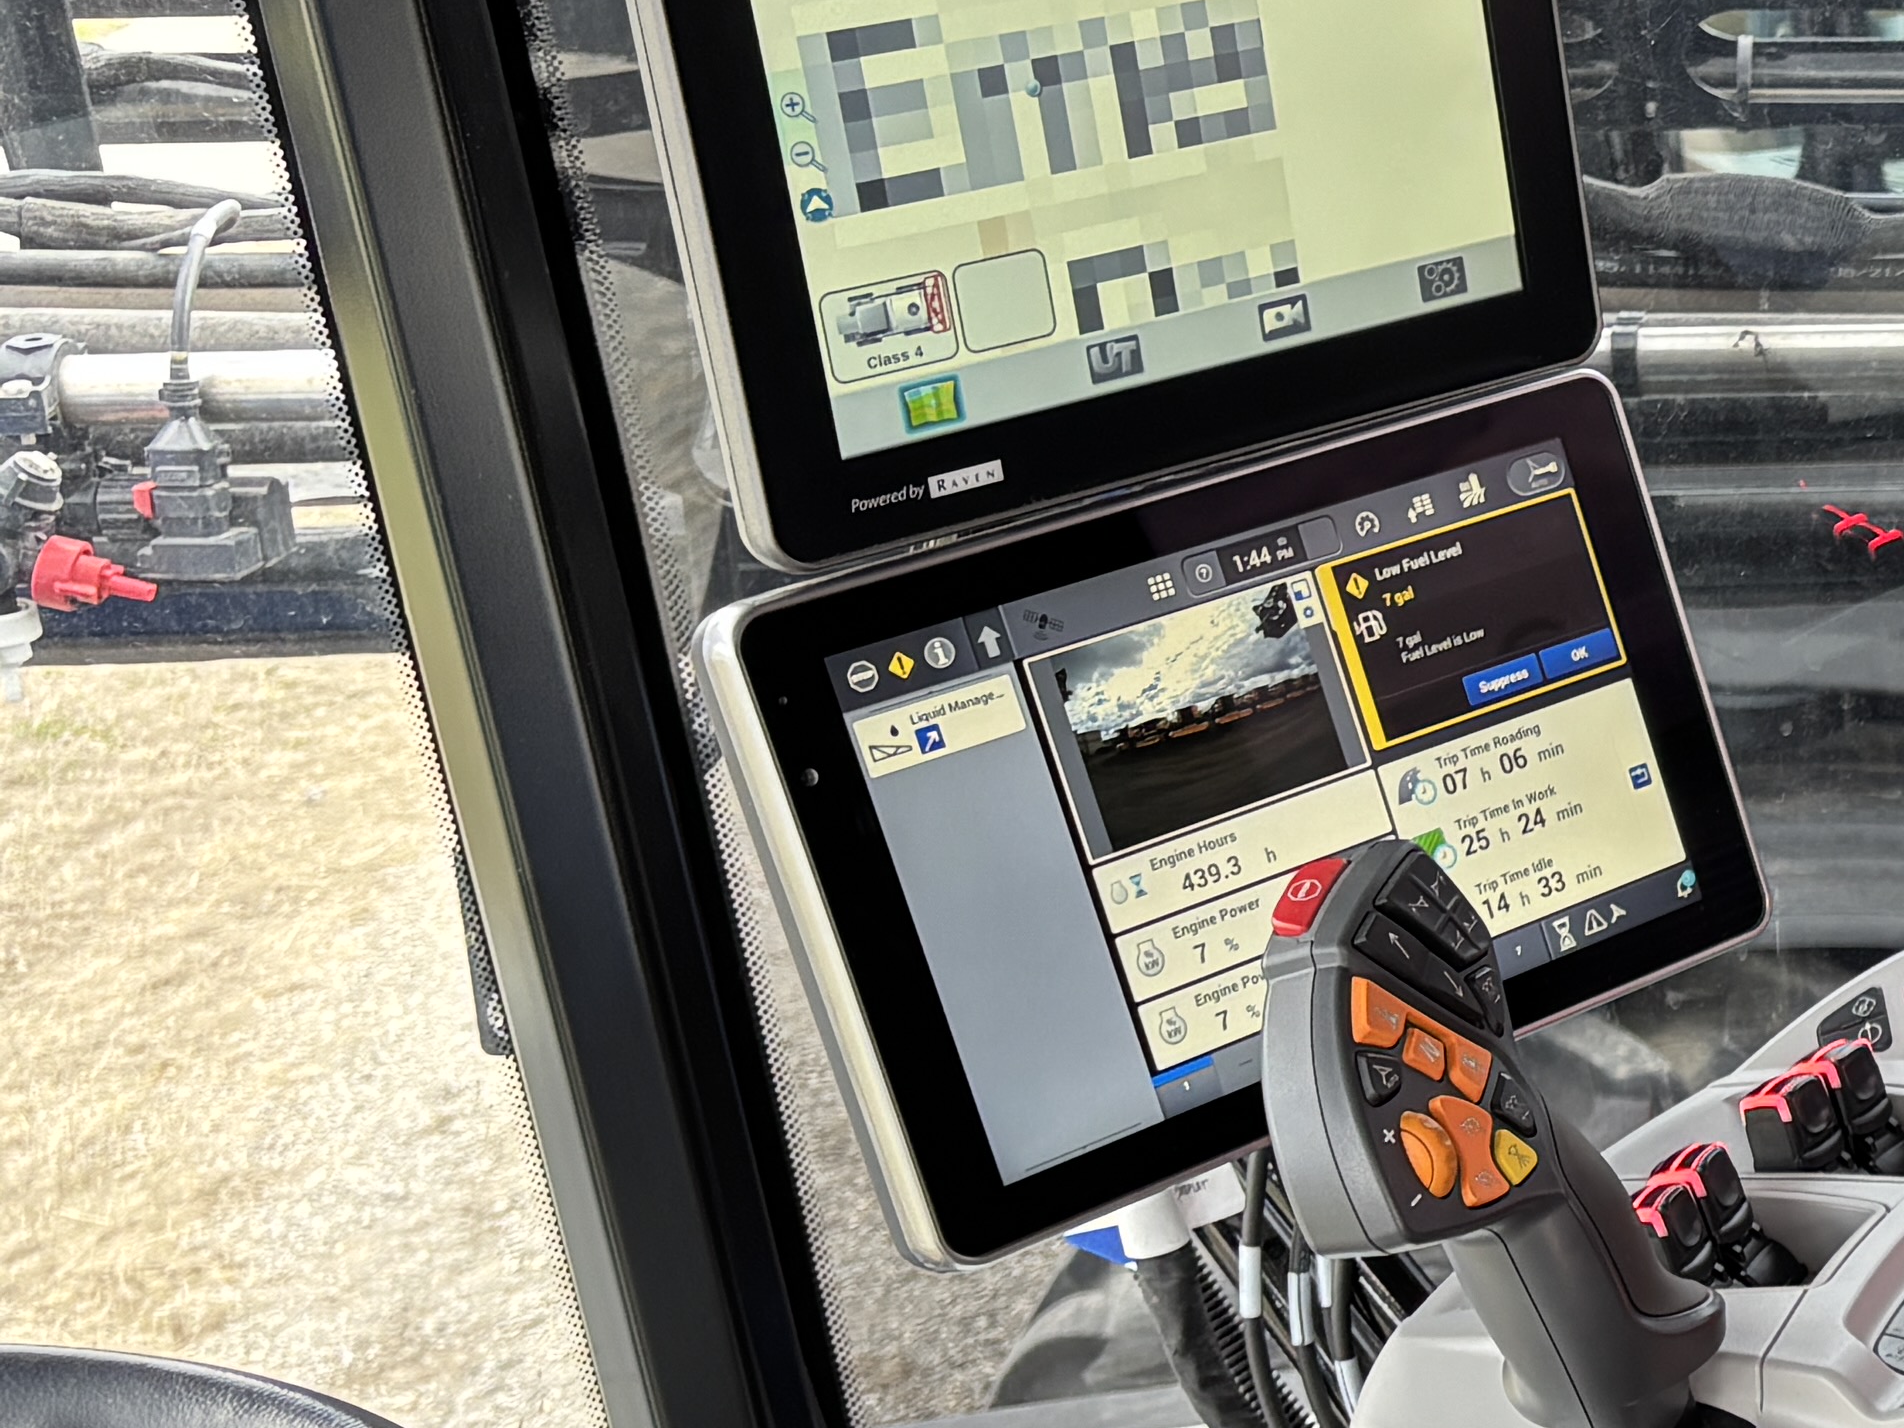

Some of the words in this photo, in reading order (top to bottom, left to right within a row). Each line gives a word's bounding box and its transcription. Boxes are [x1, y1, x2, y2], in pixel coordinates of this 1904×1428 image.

[866, 348, 909, 371] Class
[914, 345, 925, 359] 4
[851, 487, 908, 514] Powered
[908, 482, 925, 501] by
[1232, 546, 1273, 573] 1:44
[1276, 545, 1294, 561] PM
[1375, 561, 1401, 582] Low
[1402, 553, 1430, 574] Fuel
[1430, 541, 1463, 566] Level
[1382, 592, 1392, 607] 7
[1394, 585, 1415, 606] gal
[1396, 636, 1405, 649] 7
[1406, 630, 1422, 649] gal
[1401, 645, 1425, 664] Fuel
[1425, 636, 1452, 657] Level
[1452, 634, 1460, 648] is
[1462, 627, 1485, 645] Low
[1570, 645, 1589, 661] OK
[1478, 667, 1529, 695] Suppress
[909, 701, 947, 726] Liquid
[1434, 753, 1459, 771] Trip
[1460, 742, 1491, 760] Time
[1492, 723, 1543, 750] Roading
[1441, 767, 1469, 795] 07
[1480, 766, 1492, 784] h
[1499, 747, 1528, 775] 06
[1537, 741, 1565, 763] min
[1454, 815, 1479, 832] Trip
[1480, 802, 1511, 822] Time
[1512, 796, 1525, 811] In
[1525, 784, 1557, 805] Work
[1460, 828, 1491, 857] 25
[1499, 827, 1511, 843] h
[1517, 807, 1547, 835] 24
[1555, 801, 1584, 823] min
[1149, 844, 1195, 872] Engine
[1199, 830, 1238, 855] Hours
[1181, 855, 1243, 893] 439.3
[1264, 846, 1278, 864] h
[1474, 879, 1500, 896] Trip
[1500, 867, 1531, 886] Time
[1531, 856, 1555, 875] Idle
[1481, 891, 1511, 920] 14
[1519, 891, 1531, 907] h
[1537, 870, 1567, 898] 33
[1574, 863, 1603, 885] min
[1171, 913, 1218, 940] Engine
[1219, 896, 1262, 921] Power
[1192, 943, 1208, 965] 7
[1223, 937, 1240, 952] %
[1193, 980, 1240, 1008] Engine
[1214, 1009, 1230, 1032] 7
[1245, 1004, 1261, 1019] %
